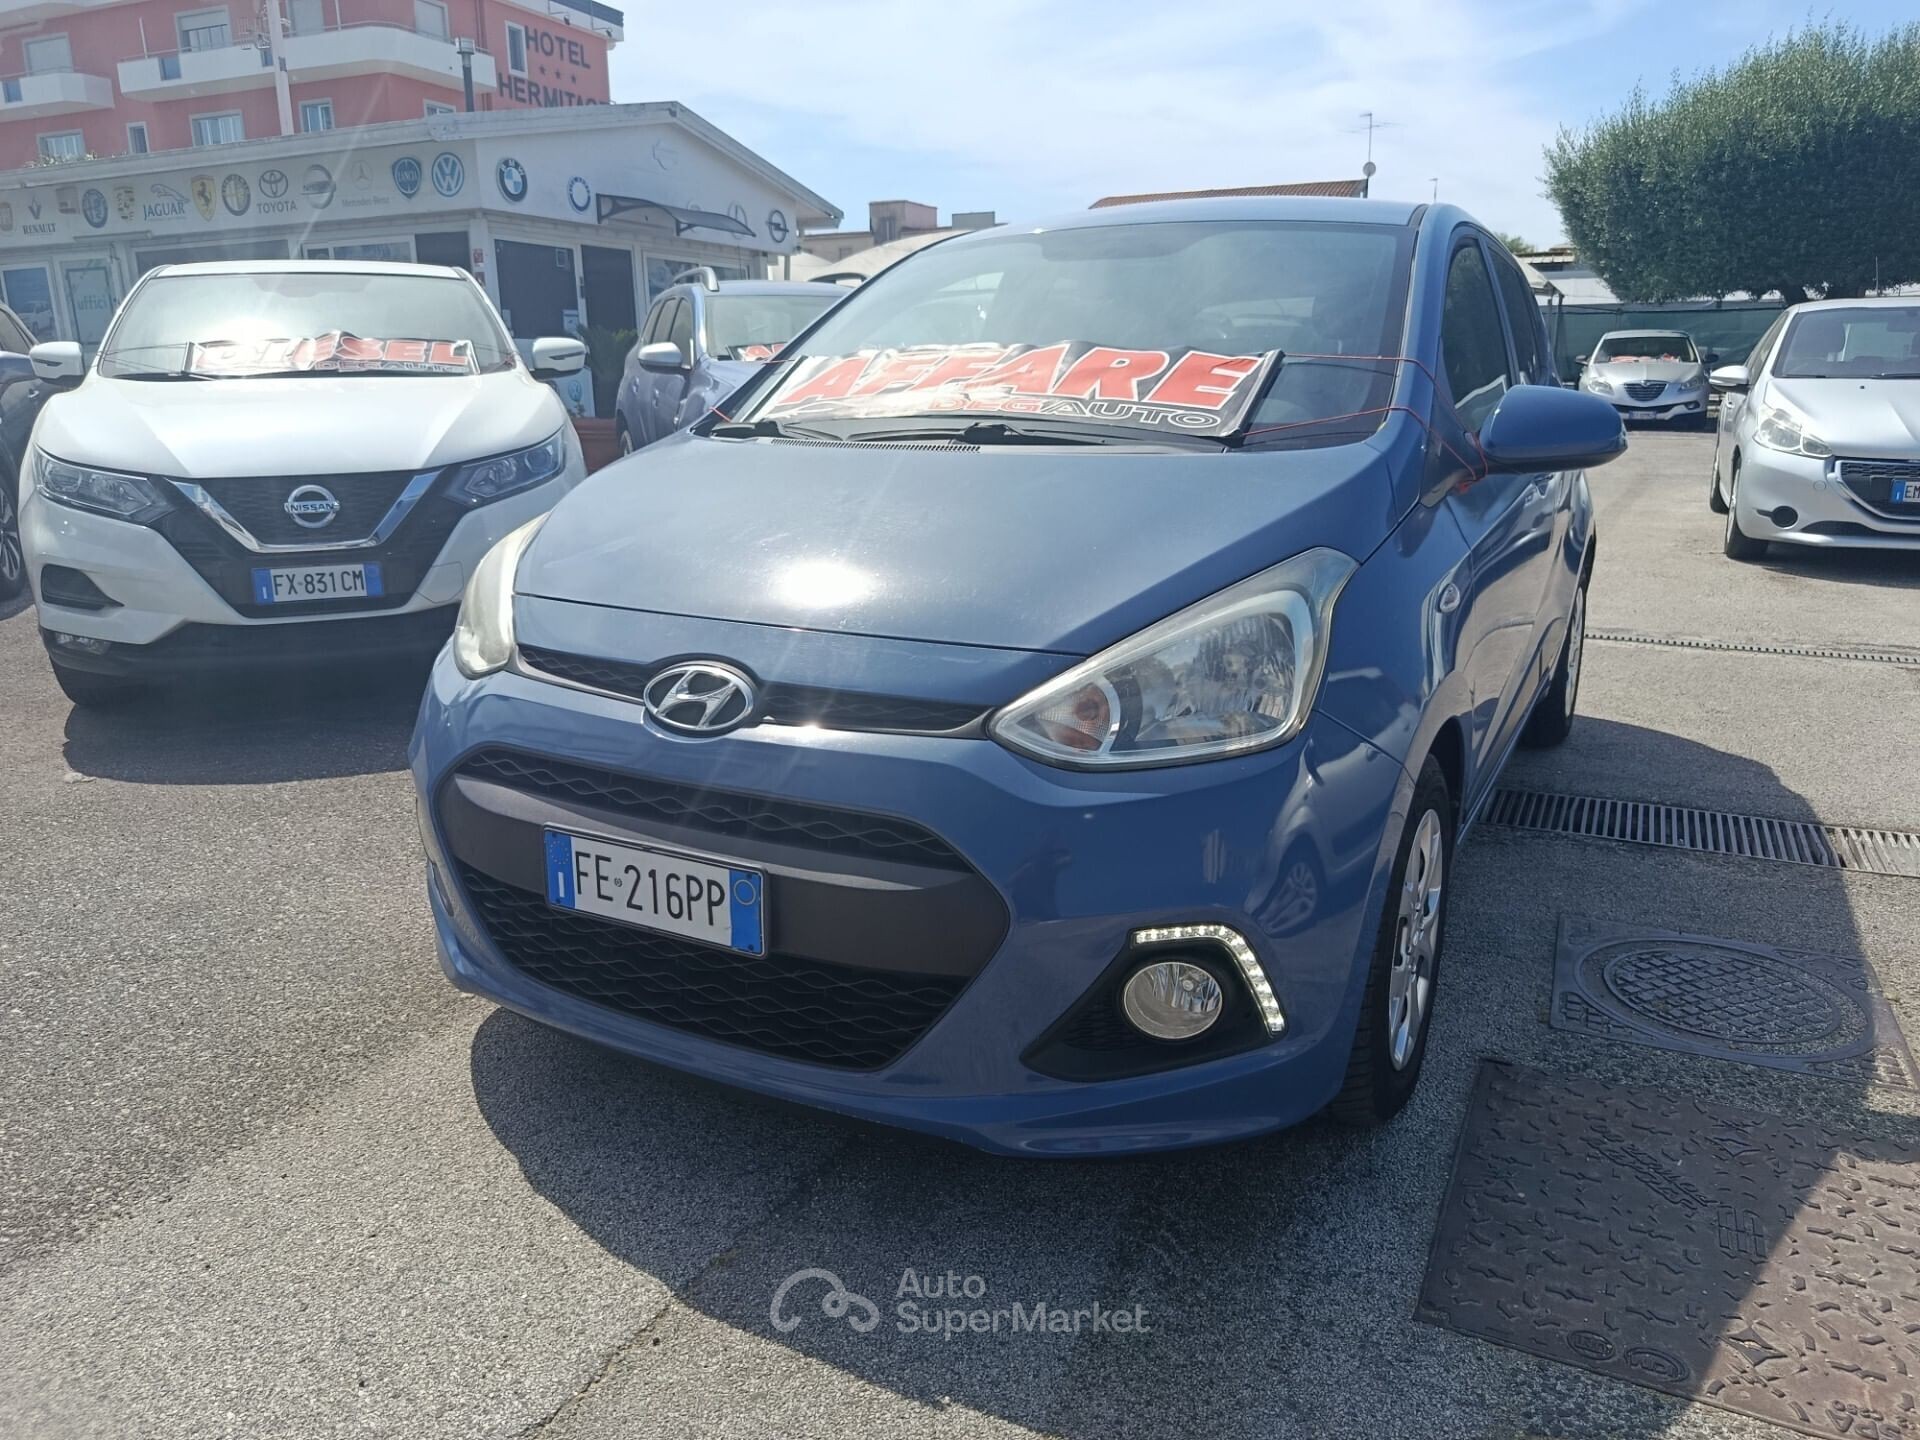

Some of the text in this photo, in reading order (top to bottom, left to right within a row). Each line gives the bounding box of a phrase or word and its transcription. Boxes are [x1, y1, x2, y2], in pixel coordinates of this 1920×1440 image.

[524, 25, 591, 70] HOTEL
[143, 203, 185, 221] JAGUAR
[256, 200, 297, 214] TOYOTA
[23, 223, 57, 235] RENAULT
[776, 340, 1263, 408] AFFARE
[290, 503, 335, 513] NISSAN
